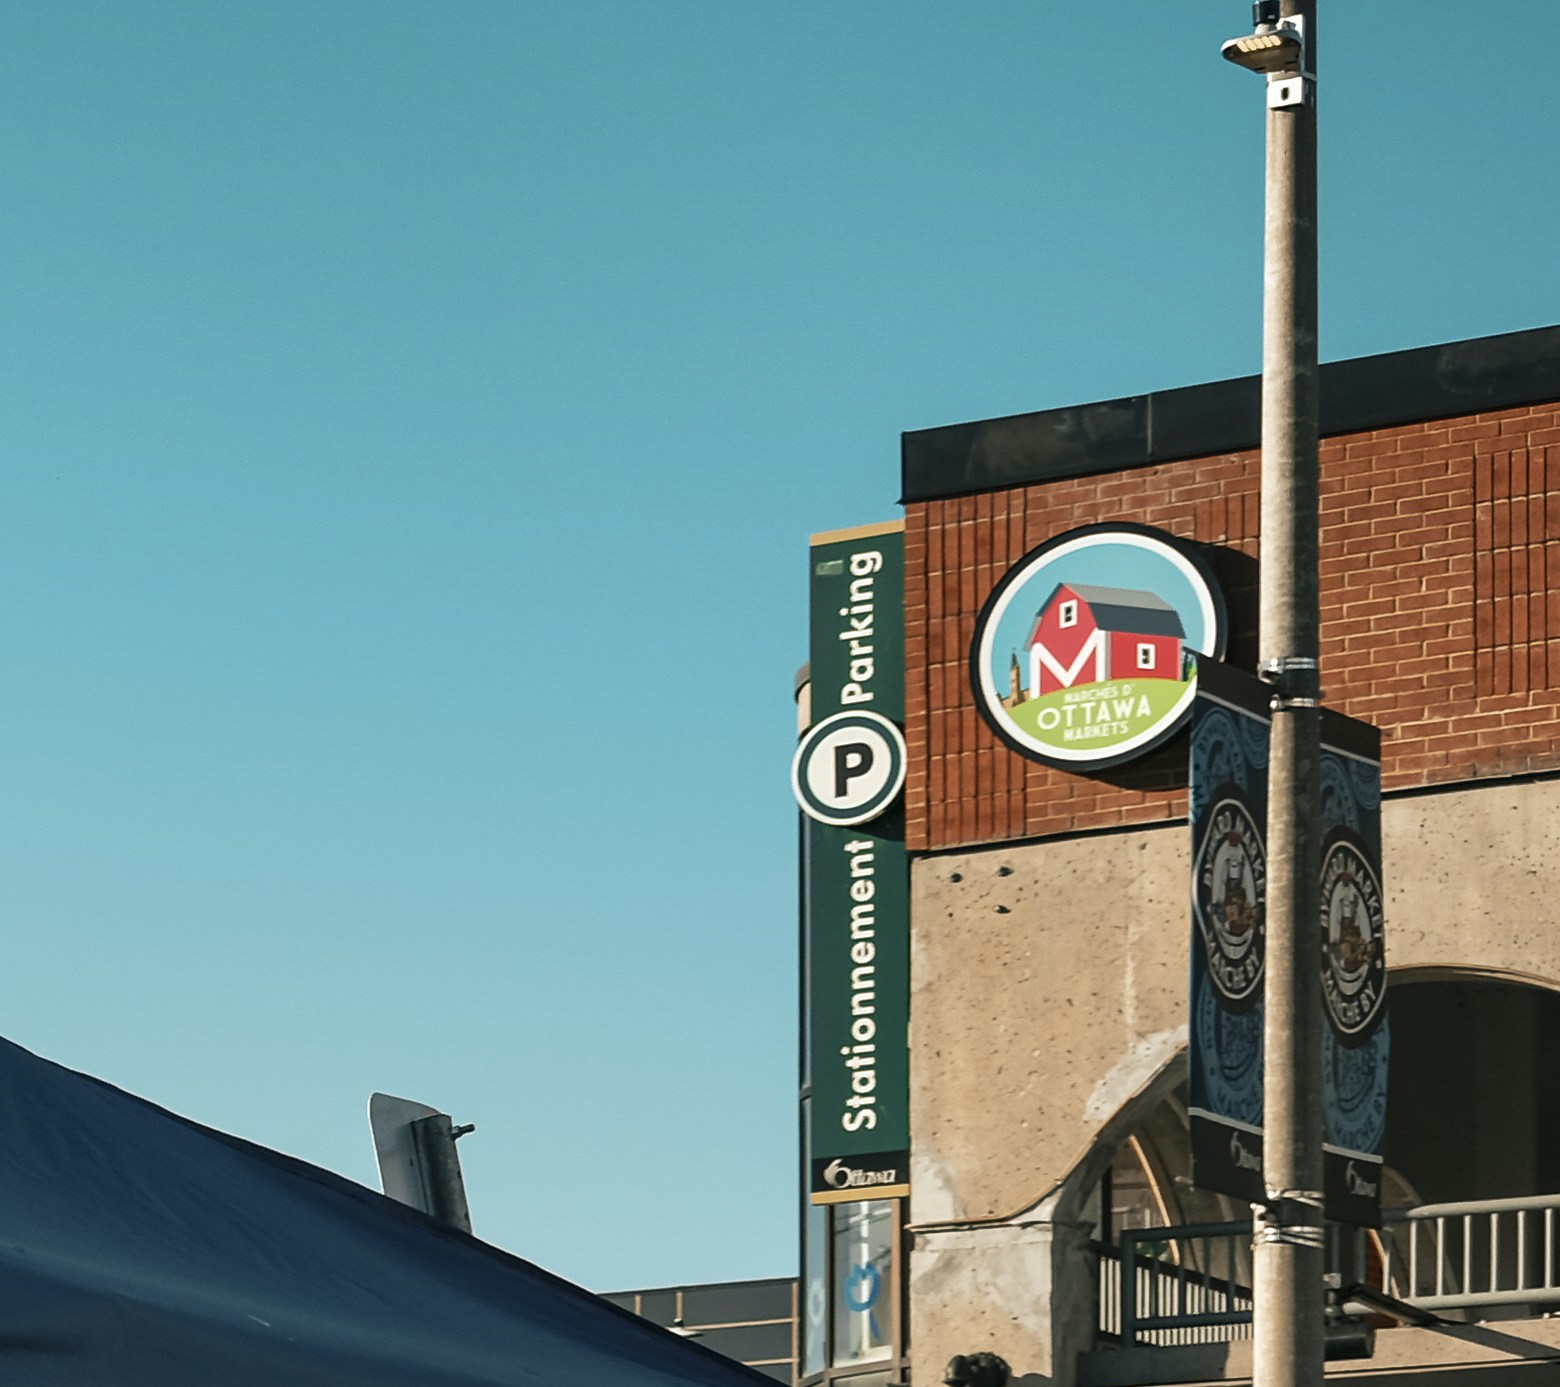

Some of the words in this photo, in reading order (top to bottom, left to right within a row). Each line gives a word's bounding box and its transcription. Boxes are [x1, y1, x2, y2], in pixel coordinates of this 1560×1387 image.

[839, 551, 883, 706] Parking
[1036, 695, 1152, 730] OTTAWA
[1063, 720, 1129, 742] MARKETS
[834, 743, 875, 798] P
[840, 839, 877, 1131] Stationnement
